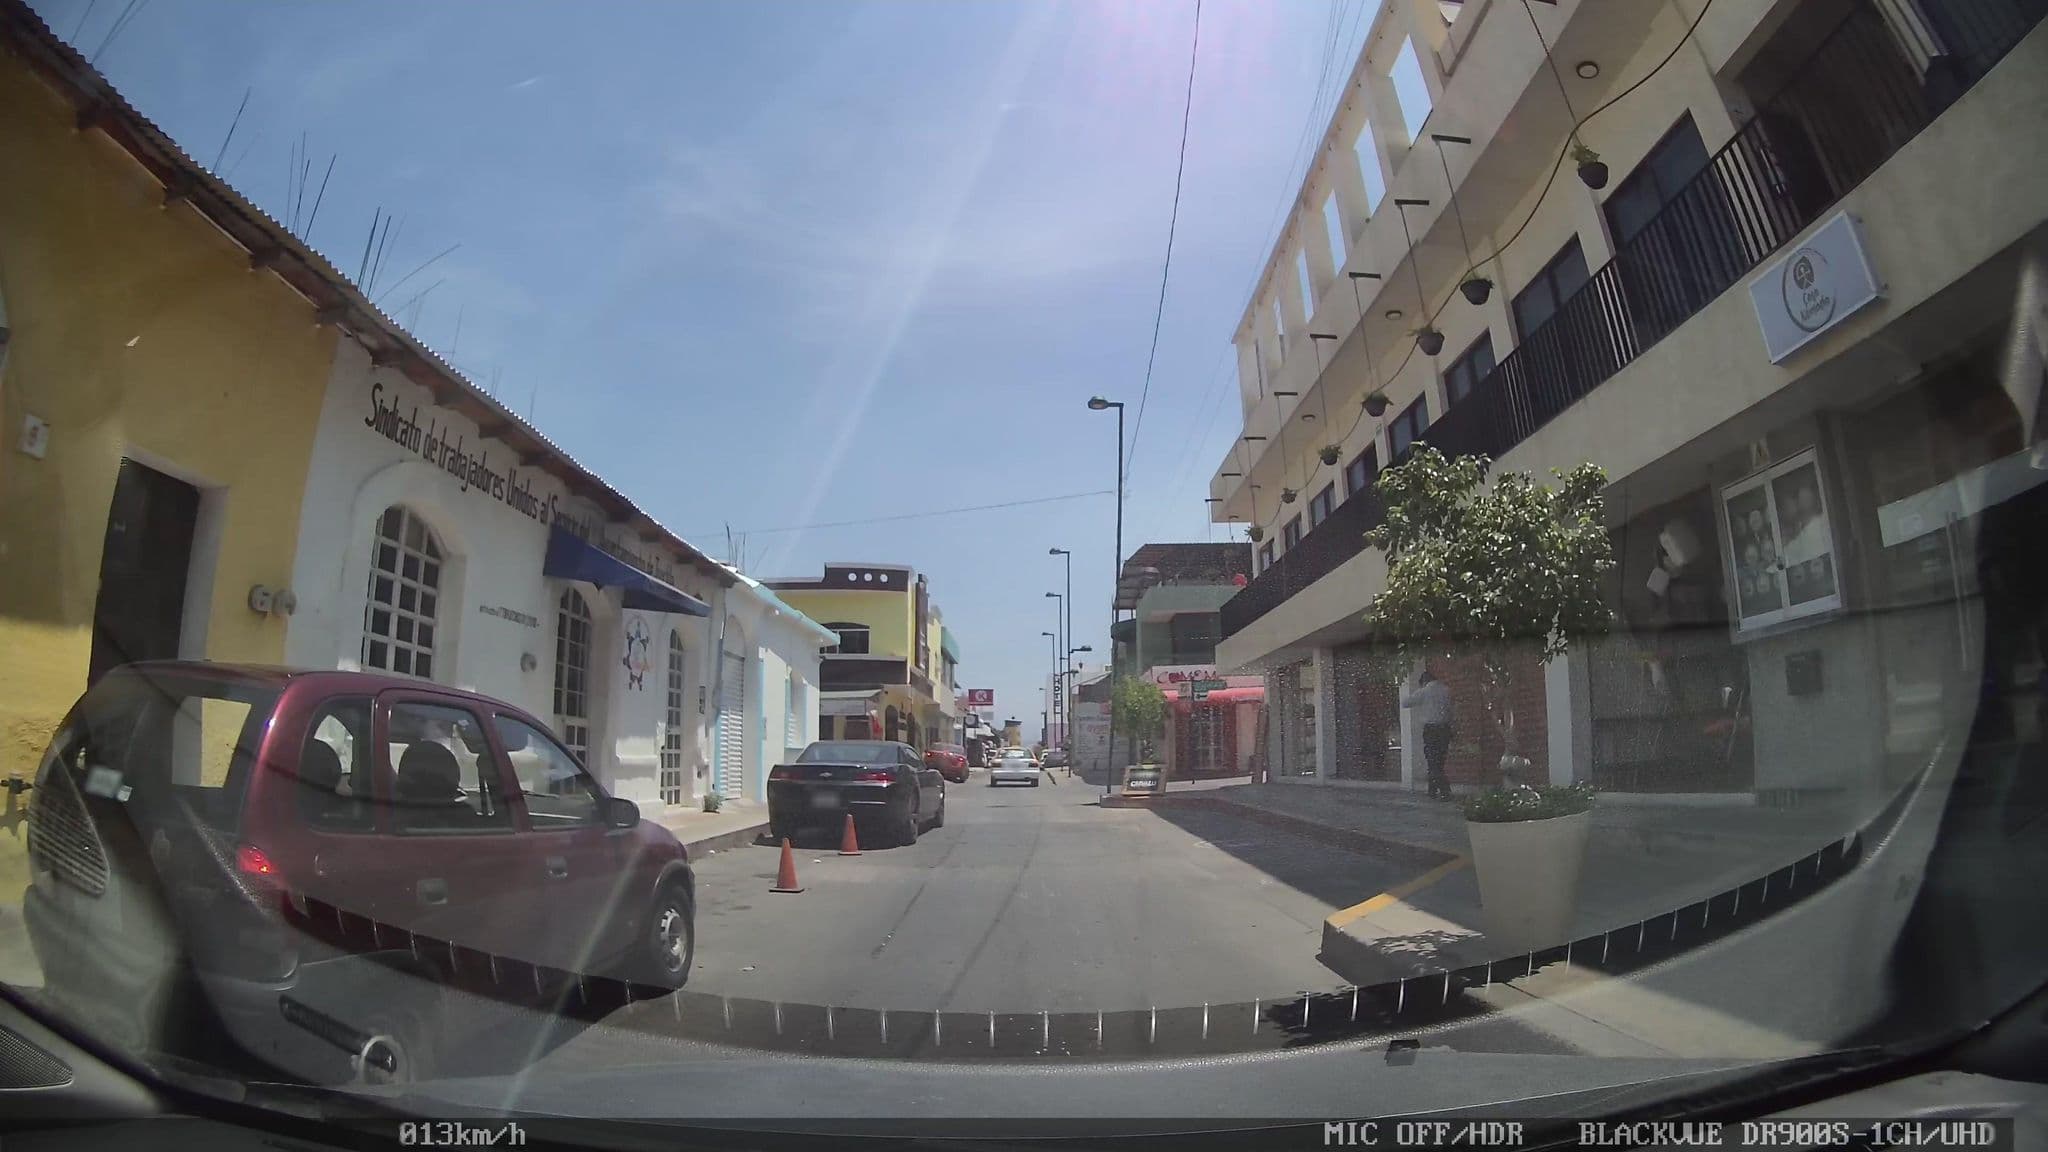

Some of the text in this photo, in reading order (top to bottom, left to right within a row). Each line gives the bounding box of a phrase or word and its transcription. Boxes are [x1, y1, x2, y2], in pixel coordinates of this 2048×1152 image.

[364, 382, 422, 454] Sindicato
[422, 417, 439, 463] de
[438, 425, 505, 502] trabajadores
[506, 467, 538, 519] Unidos
[540, 491, 551, 524] al
